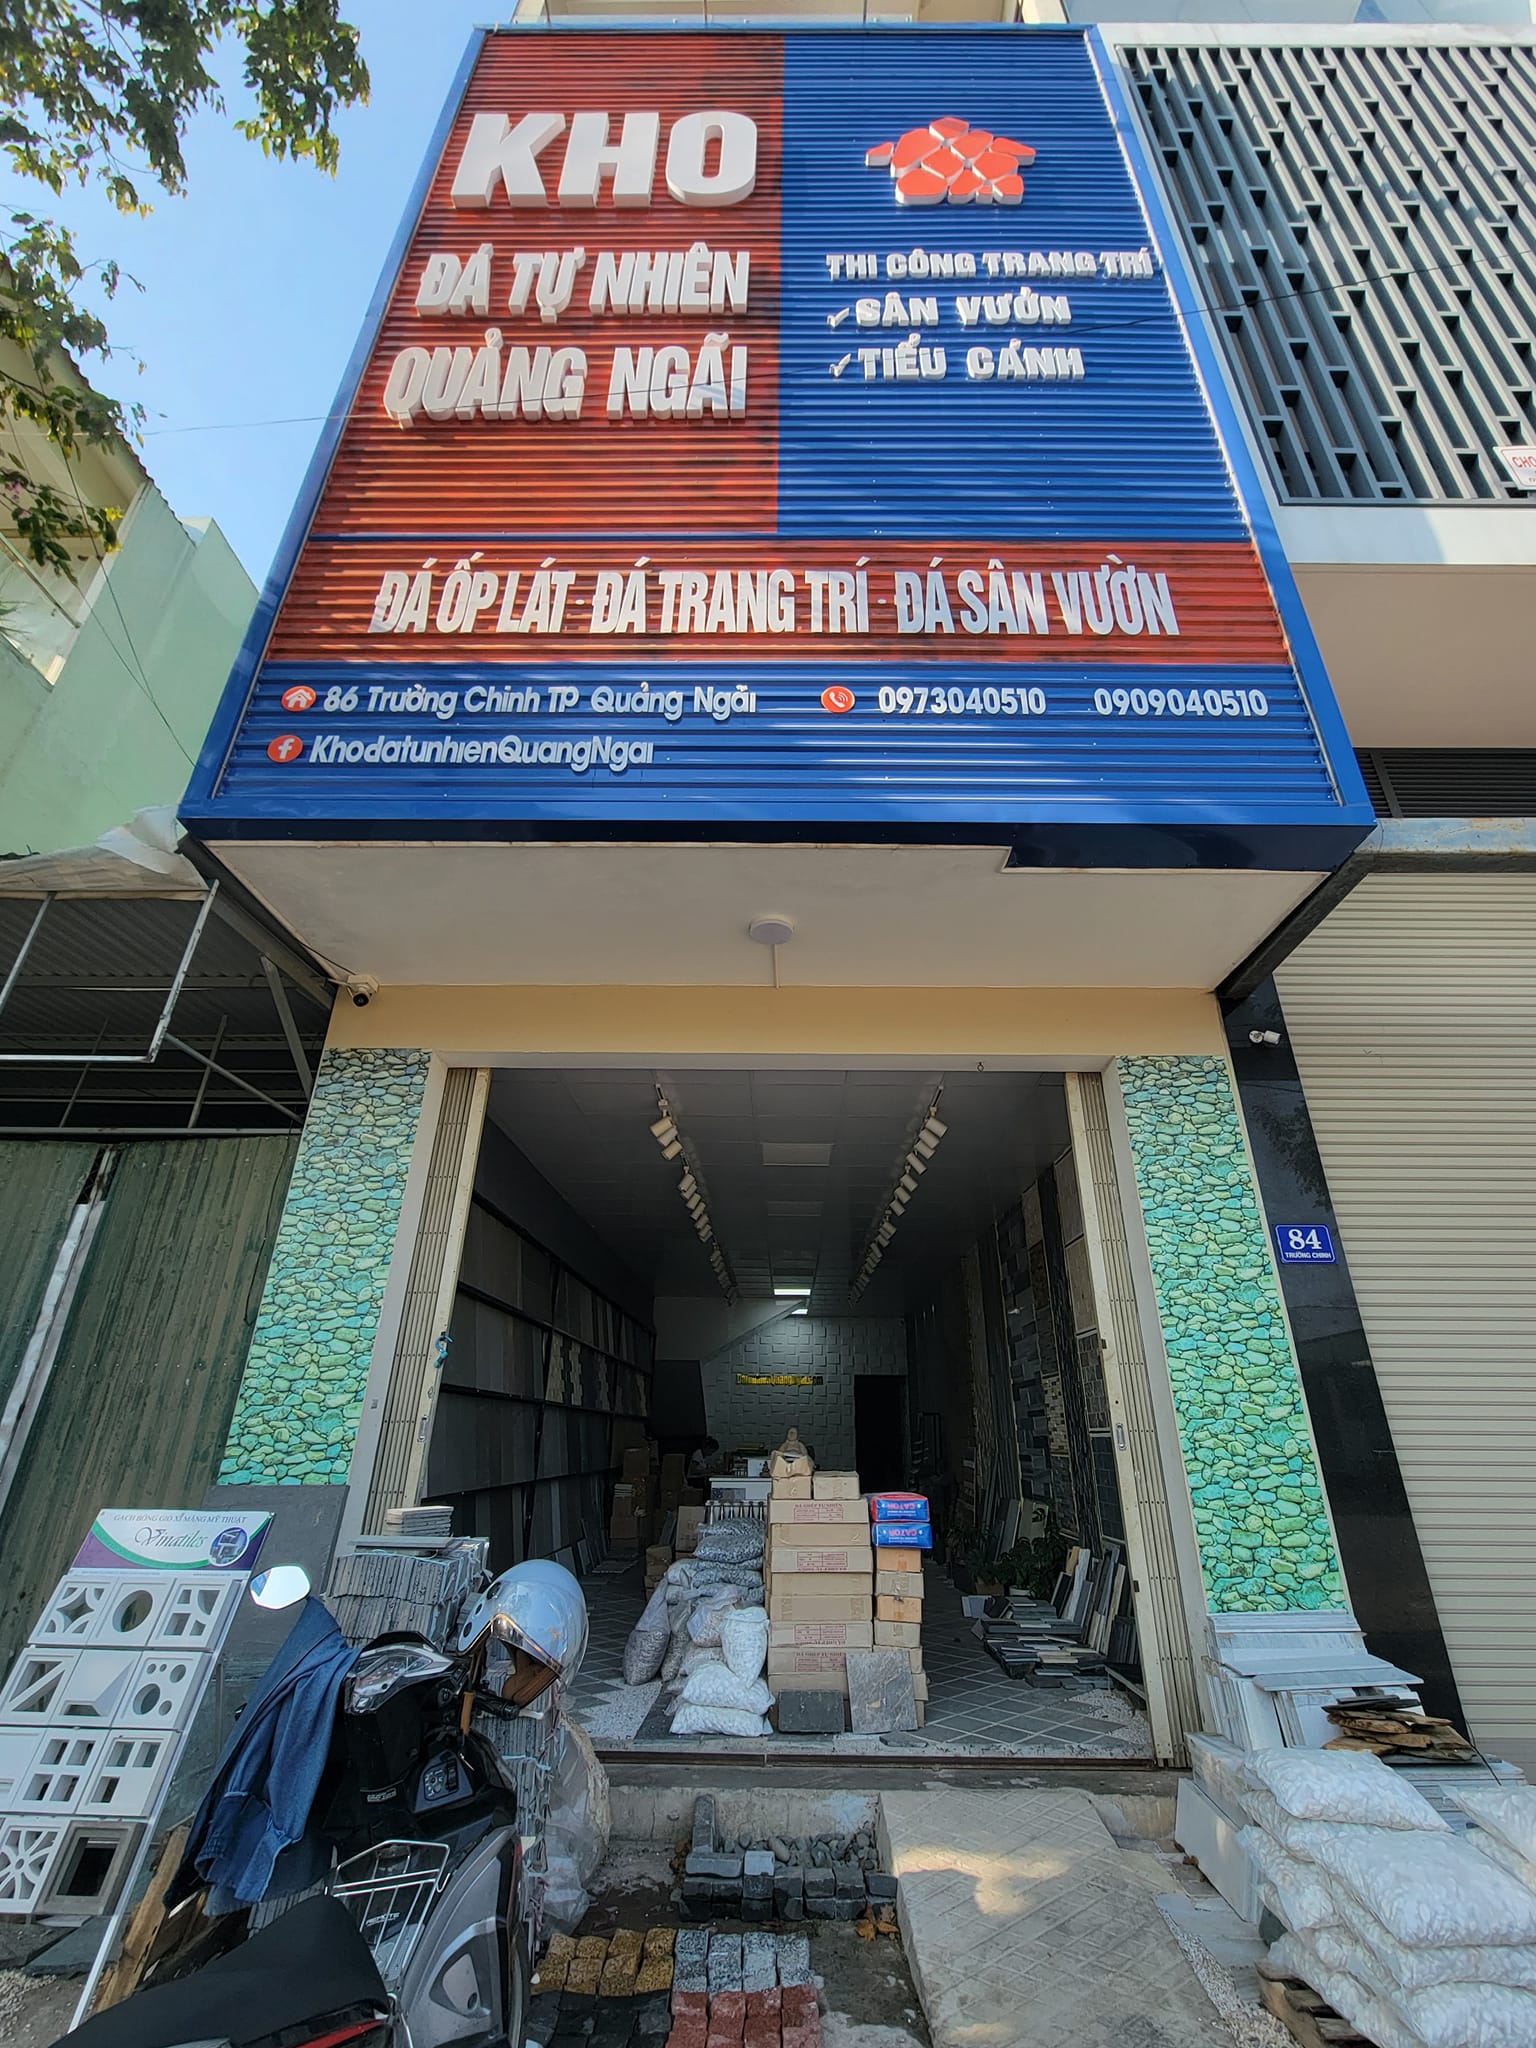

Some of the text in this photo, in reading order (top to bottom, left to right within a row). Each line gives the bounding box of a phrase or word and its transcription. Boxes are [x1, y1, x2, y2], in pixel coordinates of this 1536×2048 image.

[450, 111, 758, 208] KHO
[415, 241, 750, 324] ĐÁ TỰ NHIÊN
[826, 246, 1154, 280] THI CÔNG TRANG TRÍ
[855, 286, 1073, 327] SÂN VƯỜN
[858, 333, 1086, 381] TIỂU CẢNH
[383, 327, 748, 430] QUẢNG NGÃI
[368, 557, 438, 634] ĐÁ
[435, 551, 499, 634] ỐP
[496, 556, 576, 634] LÁT
[589, 556, 651, 634] ĐÁ
[658, 569, 795, 634] TRANG
[804, 556, 870, 633] TRÍ
[893, 556, 955, 635] ĐÁ
[957, 558, 1050, 636] SÂN
[1050, 553, 1181, 636] VƯỜN
[323, 682, 757, 721] 86 Trường Chinh TP Quảng Ngãi
[878, 686, 1270, 718] 0973040510 0909040510
[309, 734, 654, 773] KhodatunhienQuangNgai
[1288, 1228, 1322, 1250] 84
